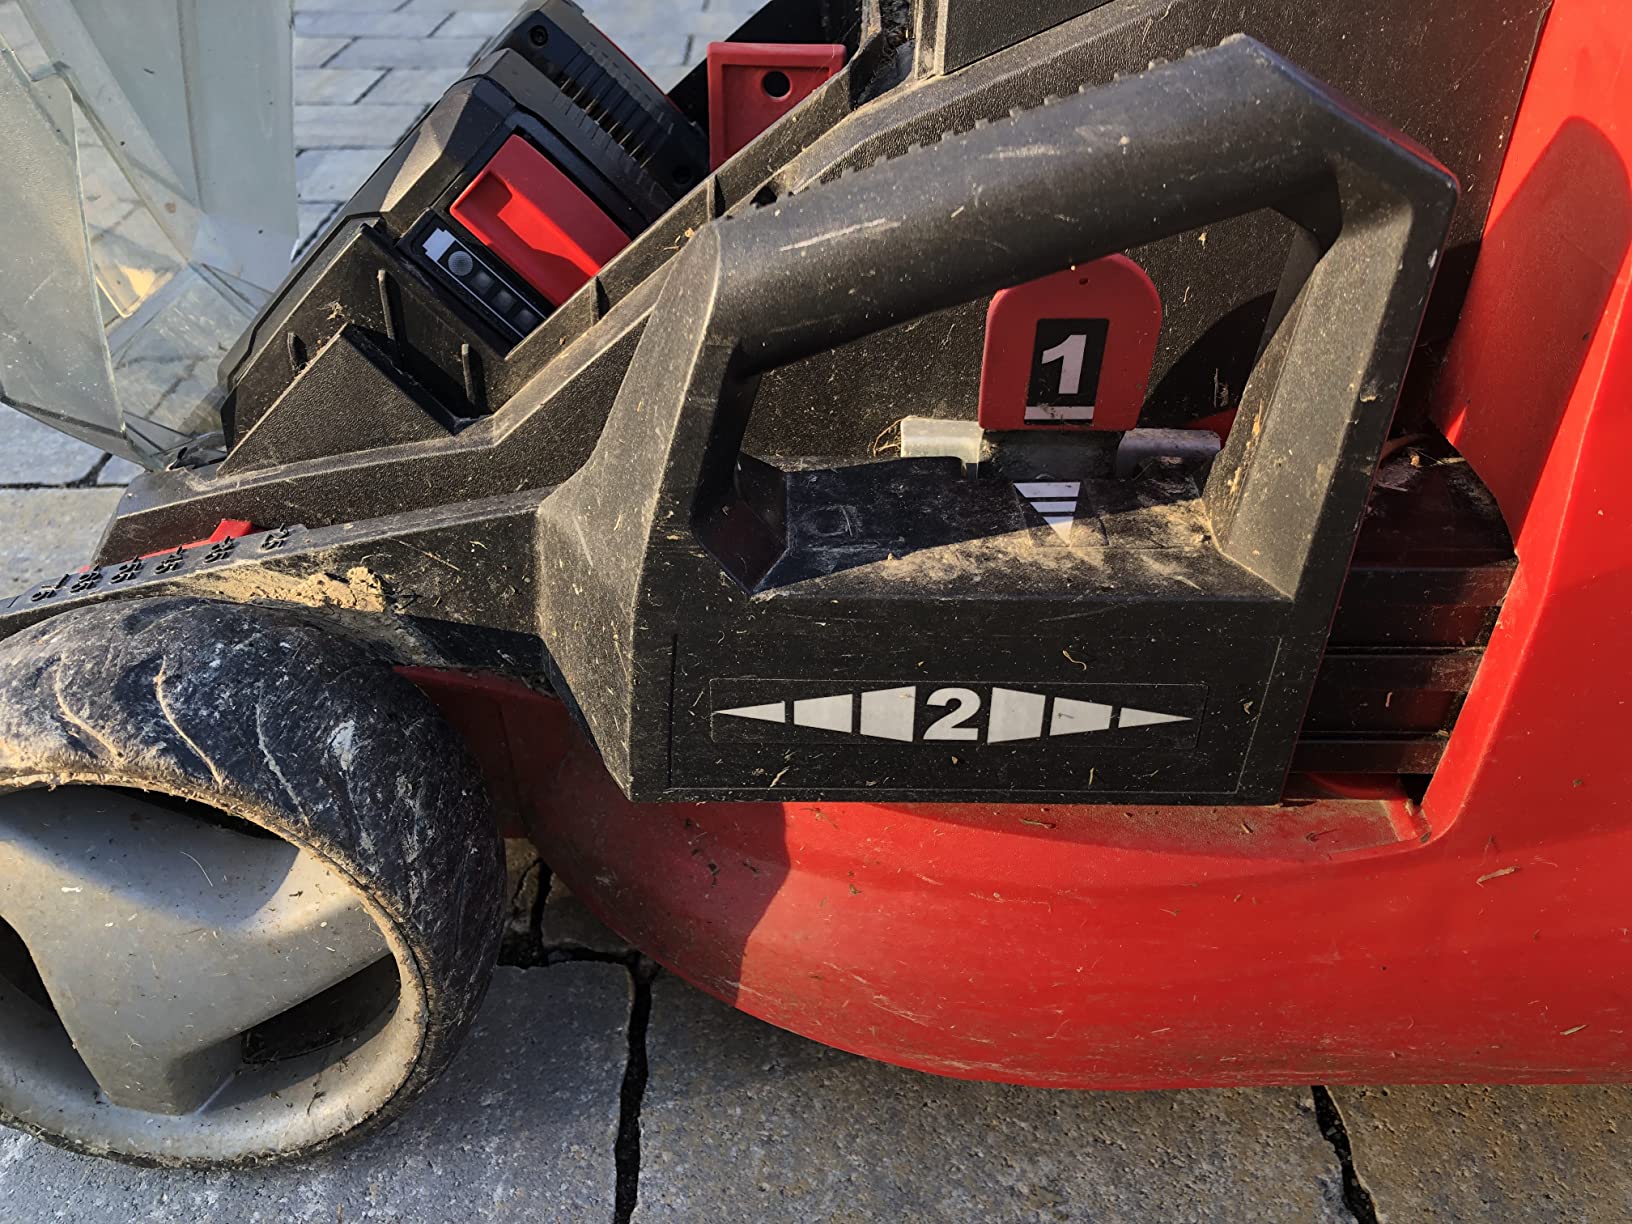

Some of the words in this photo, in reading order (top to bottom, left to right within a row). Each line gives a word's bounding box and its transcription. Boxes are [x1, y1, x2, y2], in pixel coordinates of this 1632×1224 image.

[1041, 334, 1087, 394] 1
[260, 523, 290, 551] 25
[923, 687, 981, 741] 2
